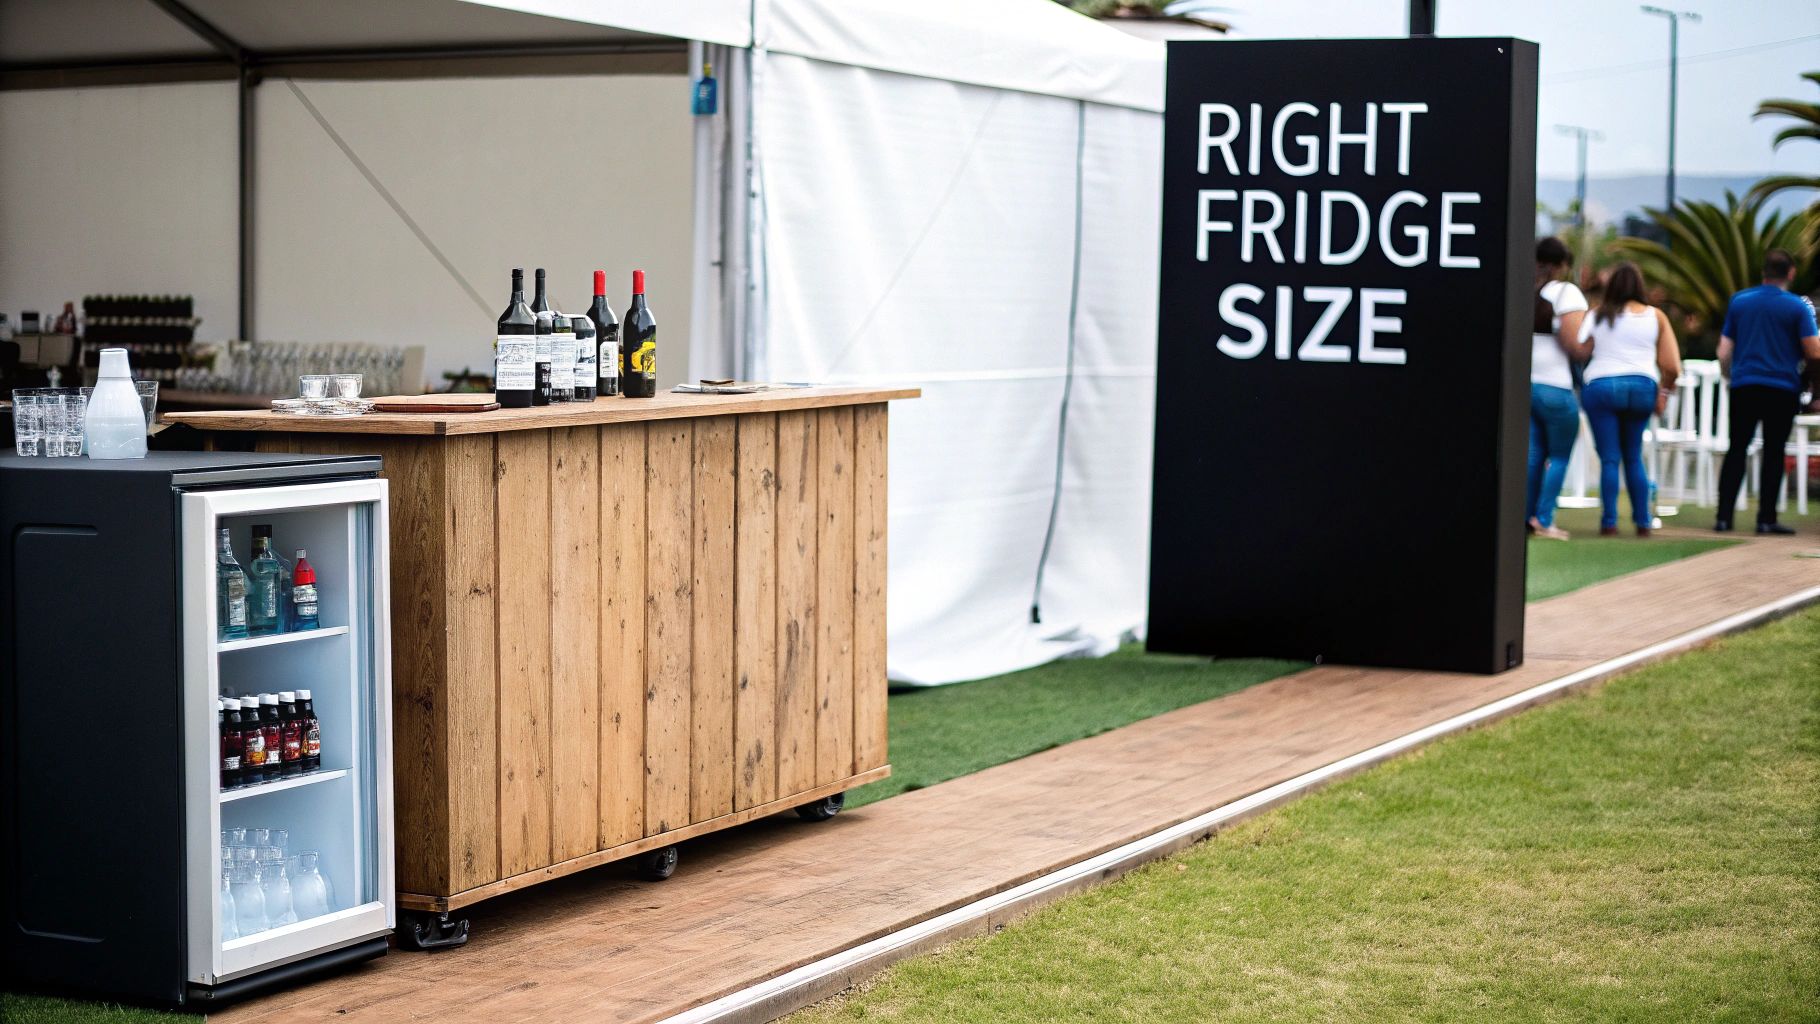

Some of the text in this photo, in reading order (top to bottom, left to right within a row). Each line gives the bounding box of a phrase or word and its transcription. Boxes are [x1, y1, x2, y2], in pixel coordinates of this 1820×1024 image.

[1197, 103, 1429, 176] RIGHT
[1196, 190, 1481, 269] FRIDGE
[1216, 284, 1407, 365] SIZE
